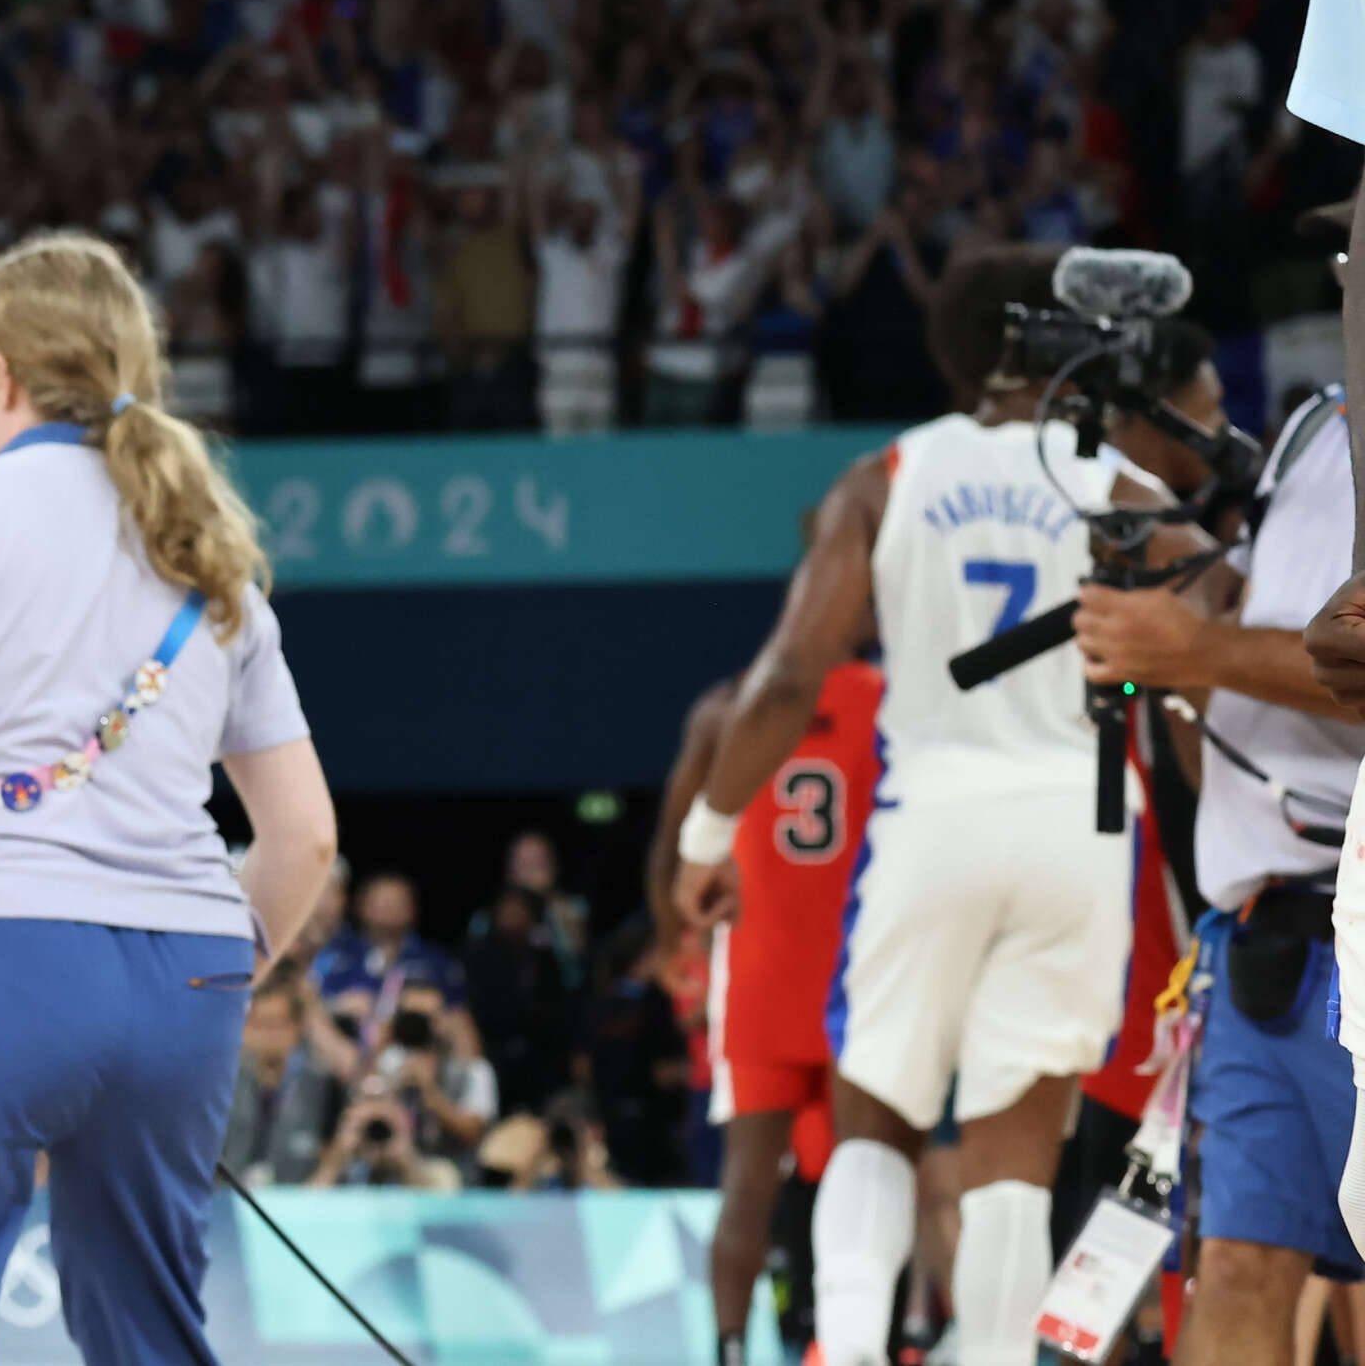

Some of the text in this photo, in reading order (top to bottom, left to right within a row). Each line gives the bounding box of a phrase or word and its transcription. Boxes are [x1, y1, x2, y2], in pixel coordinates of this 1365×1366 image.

[270, 475, 569, 560] 2024
[964, 560, 1037, 685] 7
[773, 757, 848, 865] 3
